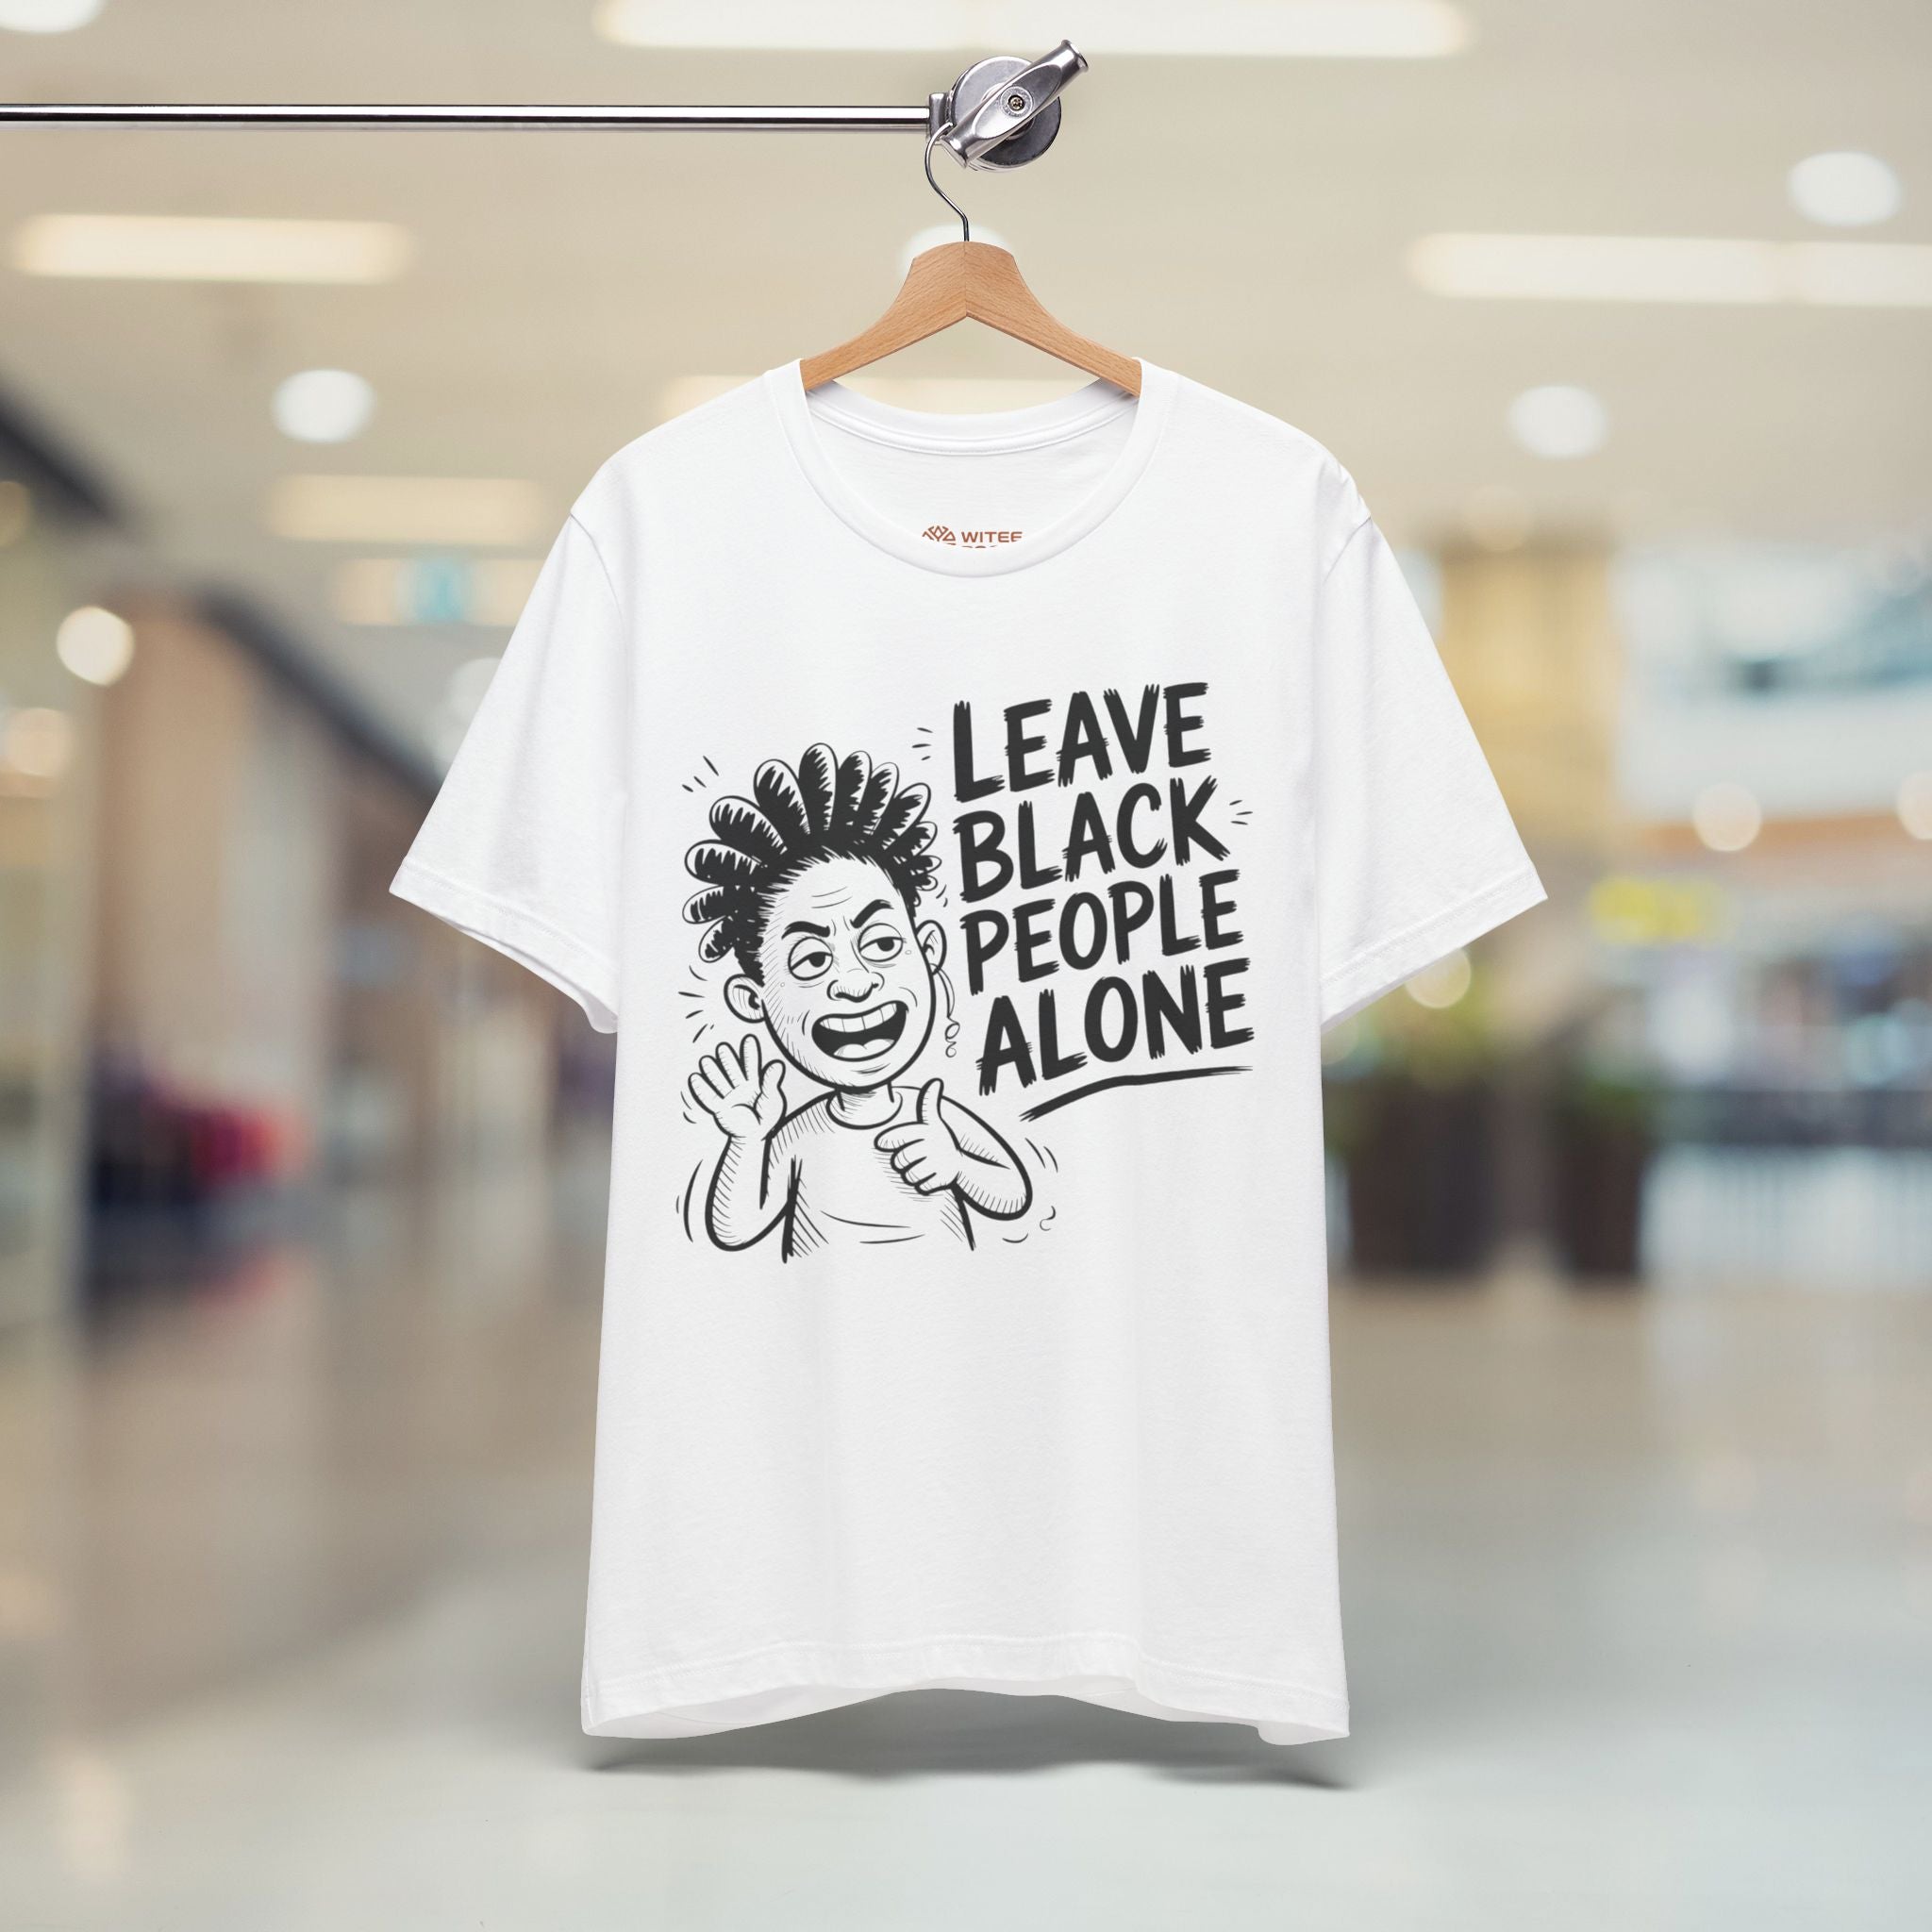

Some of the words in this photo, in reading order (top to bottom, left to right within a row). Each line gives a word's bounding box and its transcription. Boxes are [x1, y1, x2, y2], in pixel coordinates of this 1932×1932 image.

[953, 682, 1212, 803] LEAVE
[952, 775, 1231, 903] BLACK
[959, 869, 1243, 996] PEOPLE
[975, 958, 1255, 1096] ALONE
